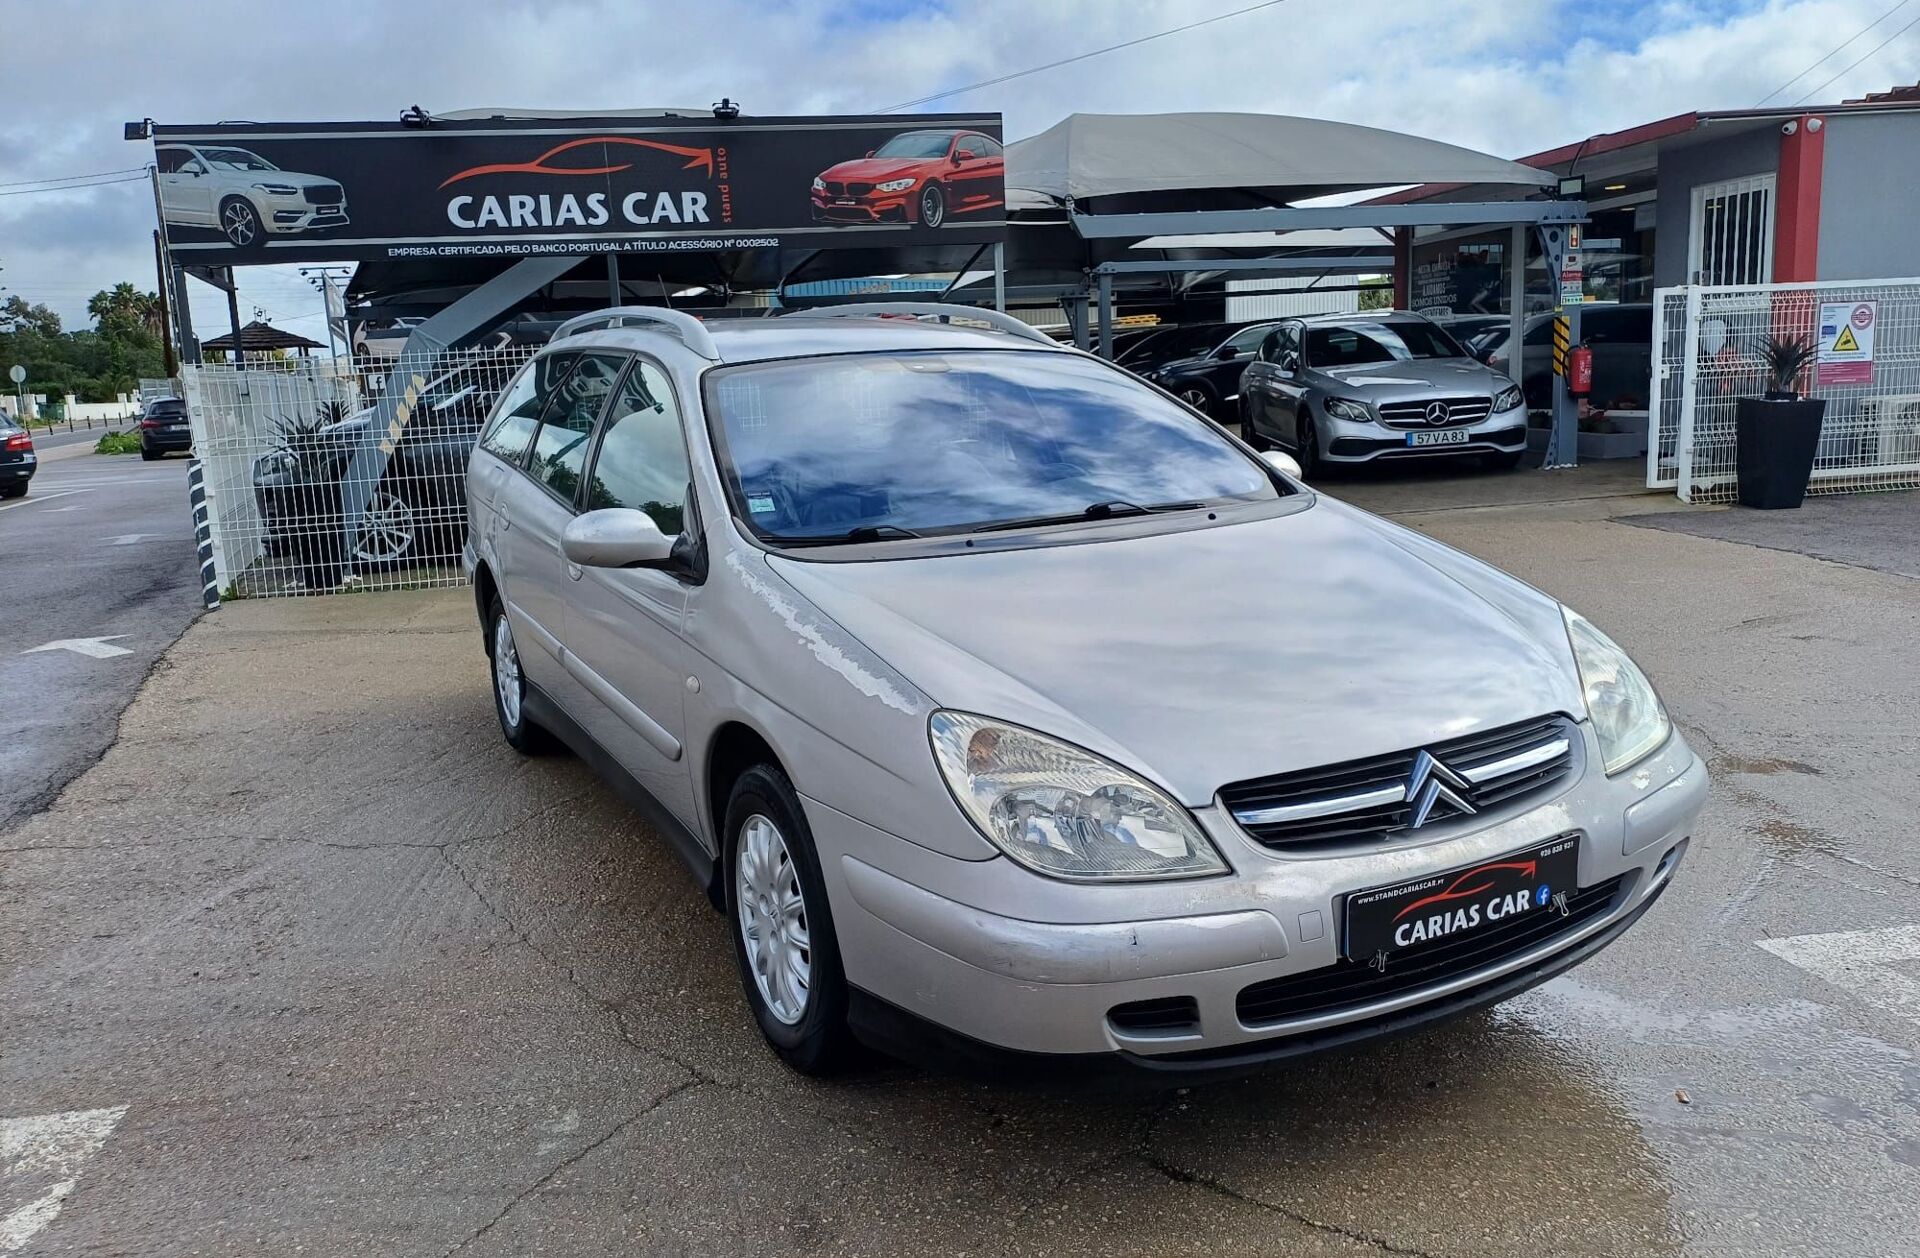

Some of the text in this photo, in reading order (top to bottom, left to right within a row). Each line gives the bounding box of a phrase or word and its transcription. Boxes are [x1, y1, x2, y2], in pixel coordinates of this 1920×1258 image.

[717, 147, 732, 223] stand auto
[447, 191, 710, 229] CARIAS CAR
[388, 247, 437, 257] EMPRESA
[438, 245, 504, 256] CERTIFICADA
[504, 244, 531, 254] PELO
[532, 243, 568, 253] BANCO
[568, 241, 623, 252] PORTUGAL
[623, 242, 632, 251] A
[632, 239, 667, 250] TÍTULO
[668, 238, 724, 250] ACESSÓRIO
[735, 238, 780, 248] 0002502
[1394, 904, 1481, 947] CARIAS
[1486, 889, 1530, 921] CAR
